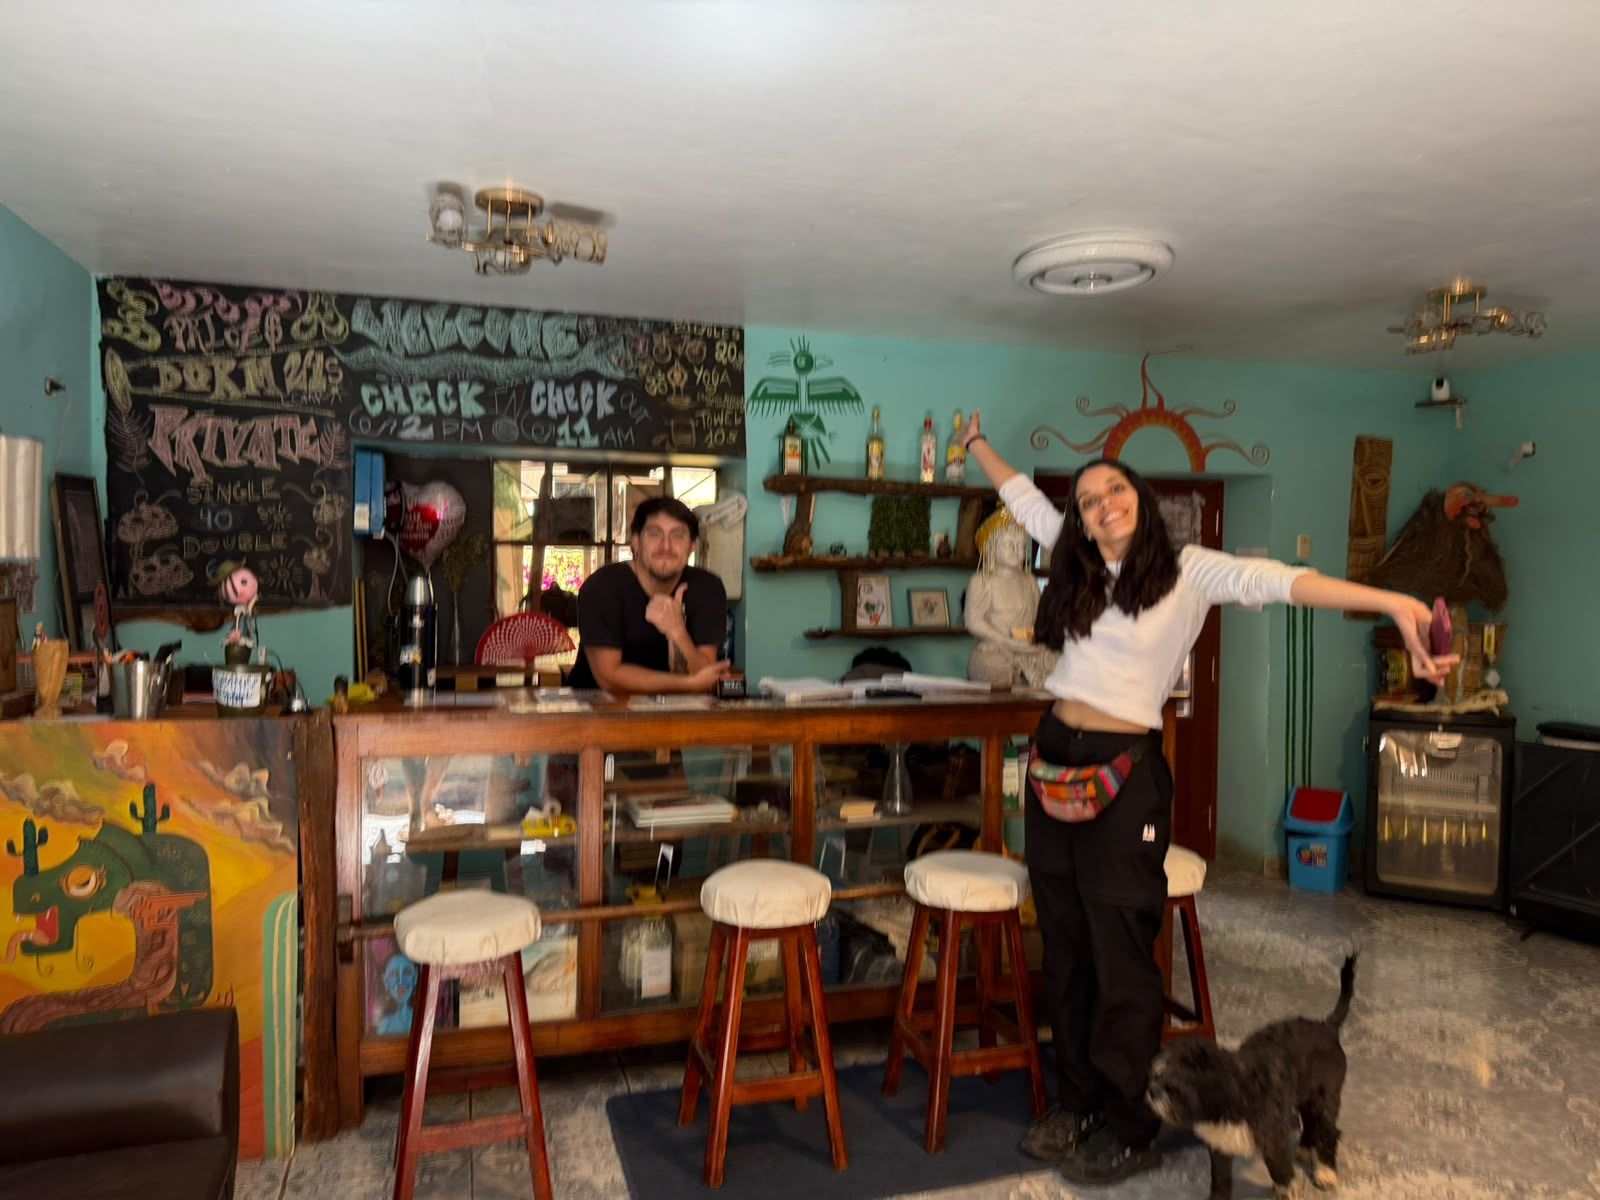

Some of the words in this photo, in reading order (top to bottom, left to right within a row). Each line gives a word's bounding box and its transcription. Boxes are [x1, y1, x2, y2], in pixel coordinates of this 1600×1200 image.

[351, 298, 580, 360] WELCOME
[152, 354, 282, 400] DORM
[360, 379, 487, 419] CHECK
[491, 388, 526, 421] IN
[530, 379, 617, 421] CHECK
[148, 404, 321, 486] PRIVATE
[398, 415, 434, 440] 2
[442, 418, 484, 442] PM
[556, 414, 600, 448] 11
[602, 425, 635, 448] AM
[186, 477, 280, 504] SINGLE
[199, 507, 233, 530] 40
[183, 531, 287, 559] DOUBLE
